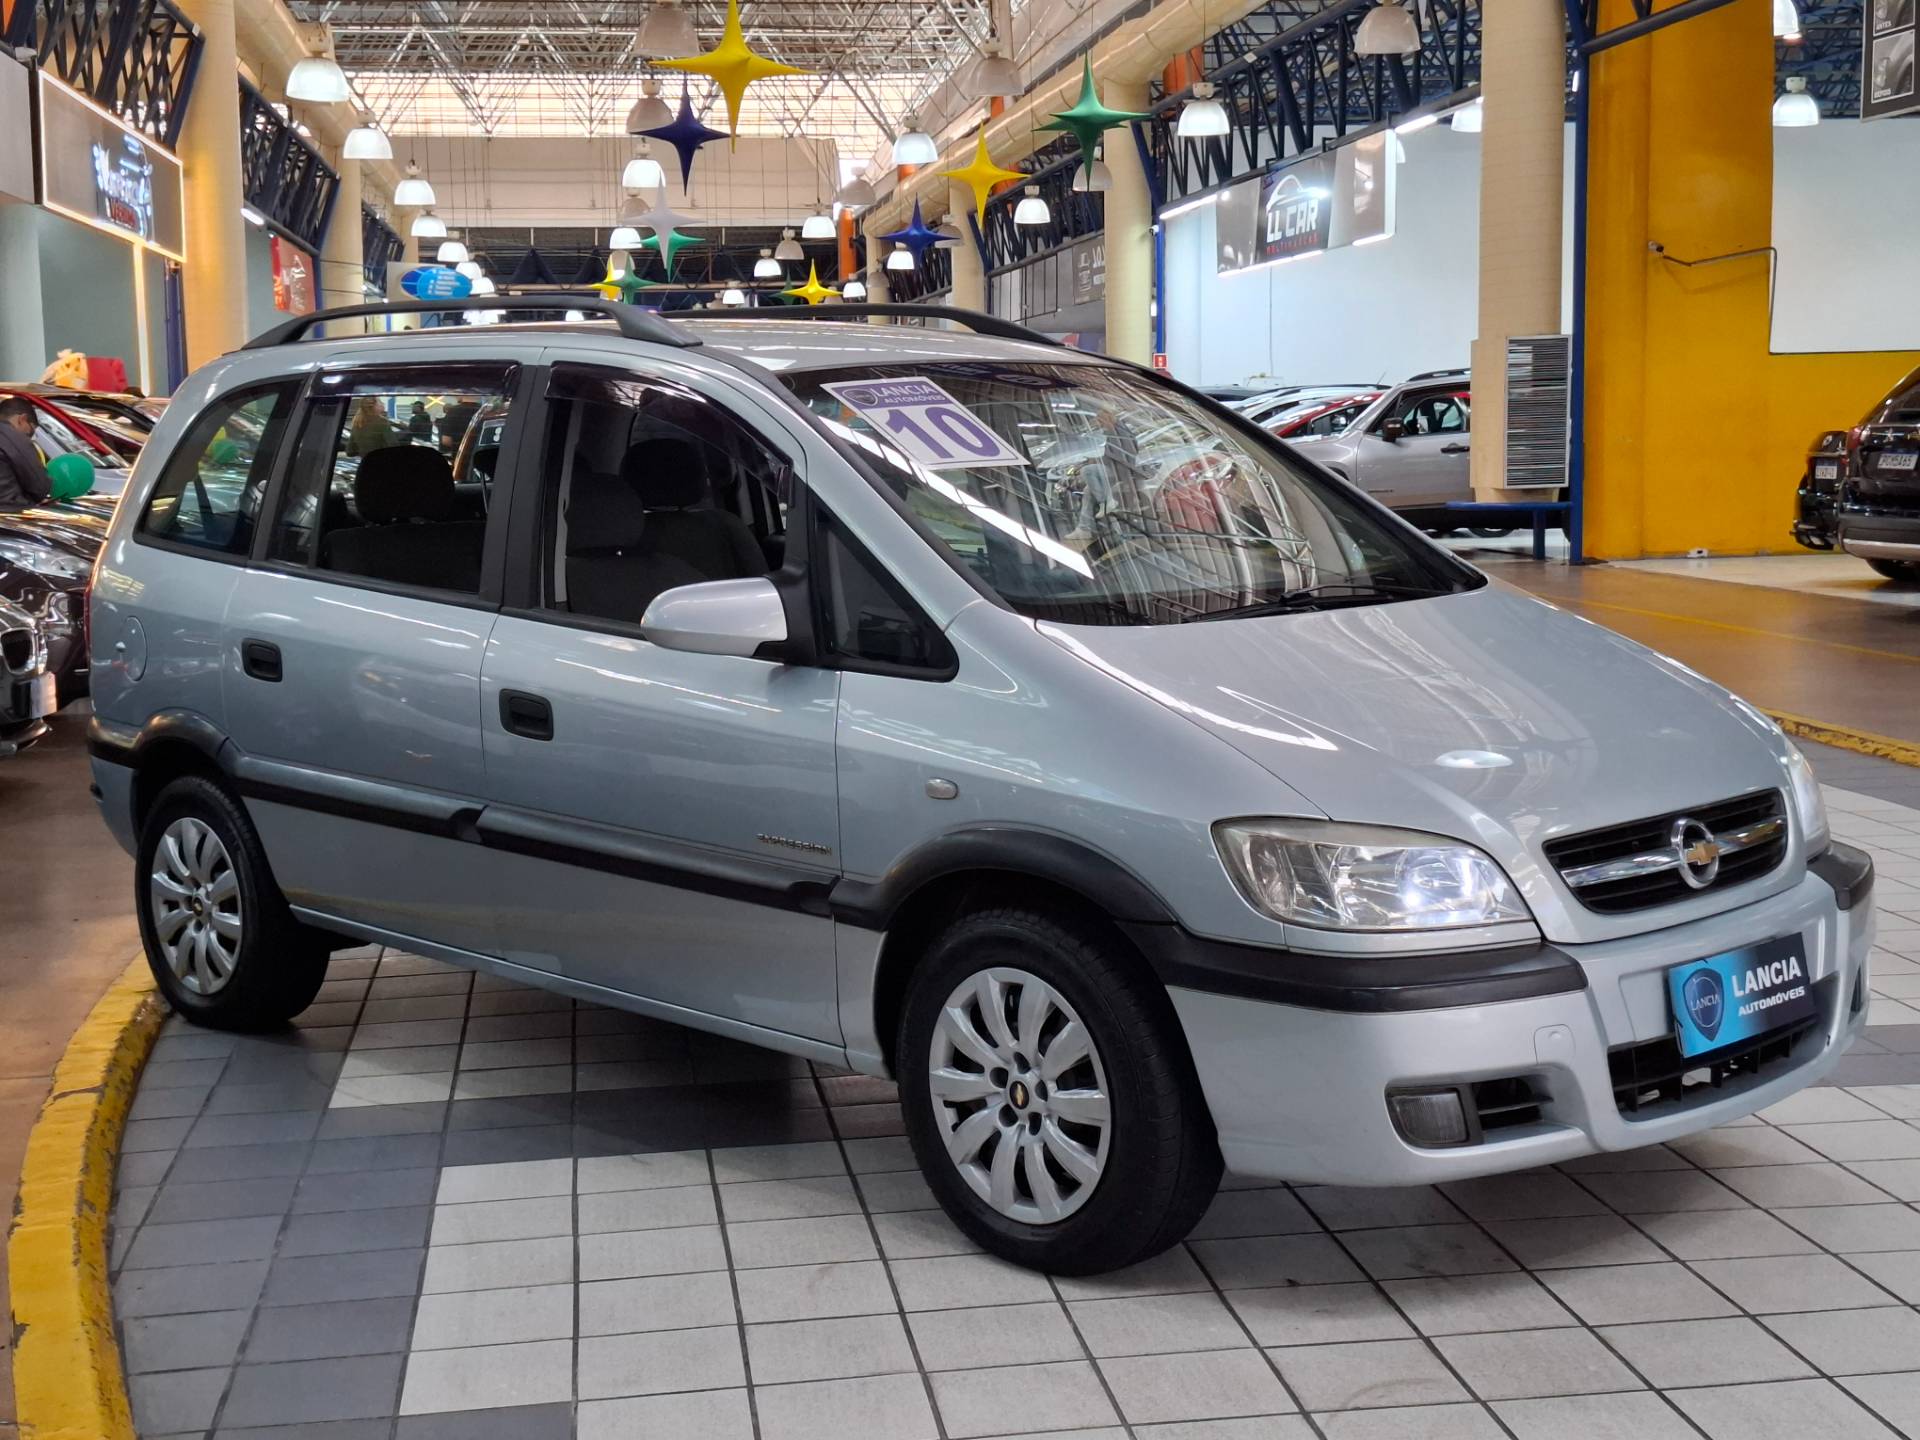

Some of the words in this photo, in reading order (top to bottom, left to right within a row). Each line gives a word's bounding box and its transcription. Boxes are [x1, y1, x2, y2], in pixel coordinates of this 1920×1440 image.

[1266, 210, 1282, 243] LL
[1285, 200, 1319, 237] CAR
[870, 383, 938, 397] LANCIA
[885, 406, 1001, 459] 10
[1732, 956, 1802, 998] LANCIA
[1690, 993, 1720, 1011] LANCIA
[1738, 986, 1806, 1016] AUTOMÓVEIS
